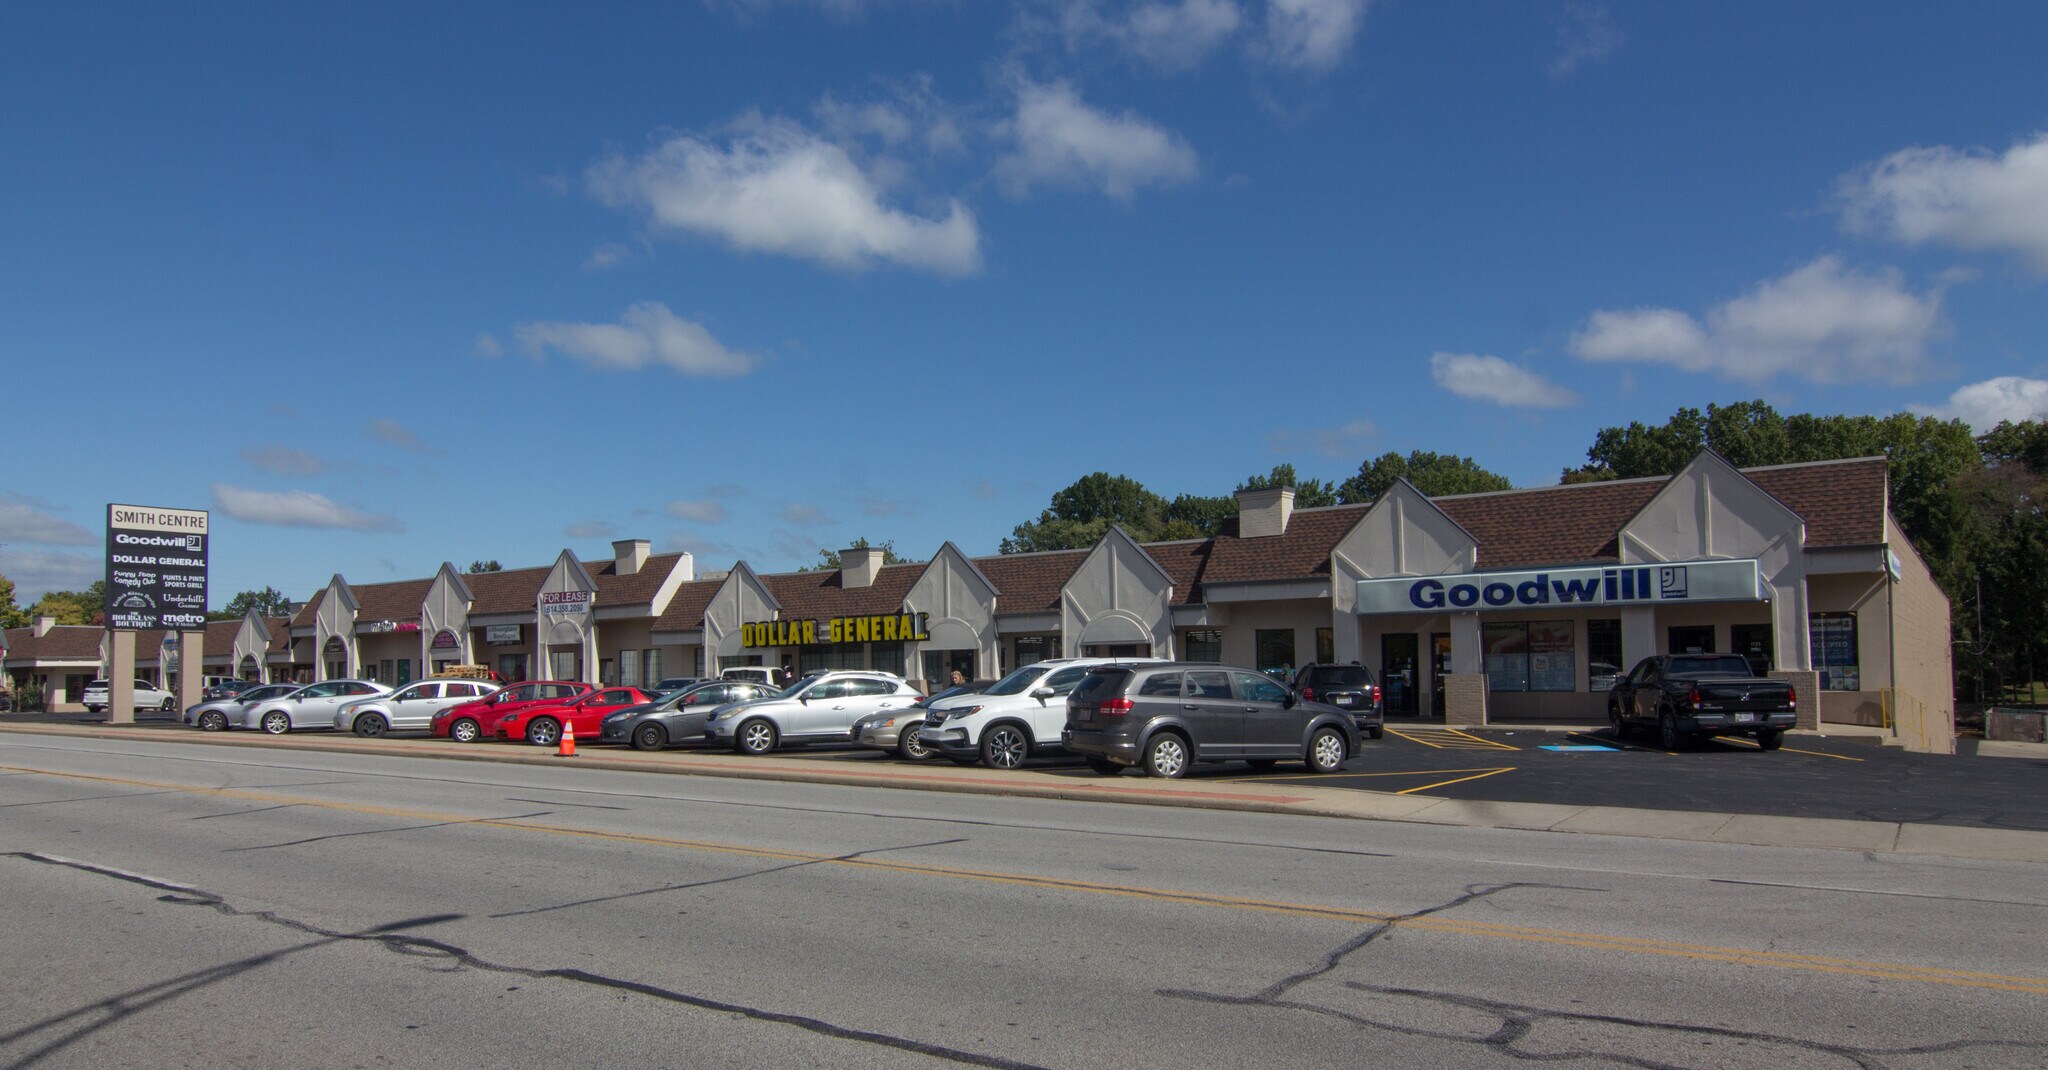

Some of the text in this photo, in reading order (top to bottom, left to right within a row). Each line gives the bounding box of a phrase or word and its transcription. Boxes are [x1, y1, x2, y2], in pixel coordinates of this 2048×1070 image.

[115, 511, 205, 528] SMITH CENTRE
[116, 534, 186, 547] Goodwill
[113, 555, 205, 567] DOLLAR GENERAL
[1409, 568, 1652, 609] Goodwill
[543, 592, 587, 603] FOR LEASE
[115, 620, 154, 628] BOUTIQUE
[162, 613, 205, 623] metro
[741, 612, 931, 648] DOLLAR GENERAL
